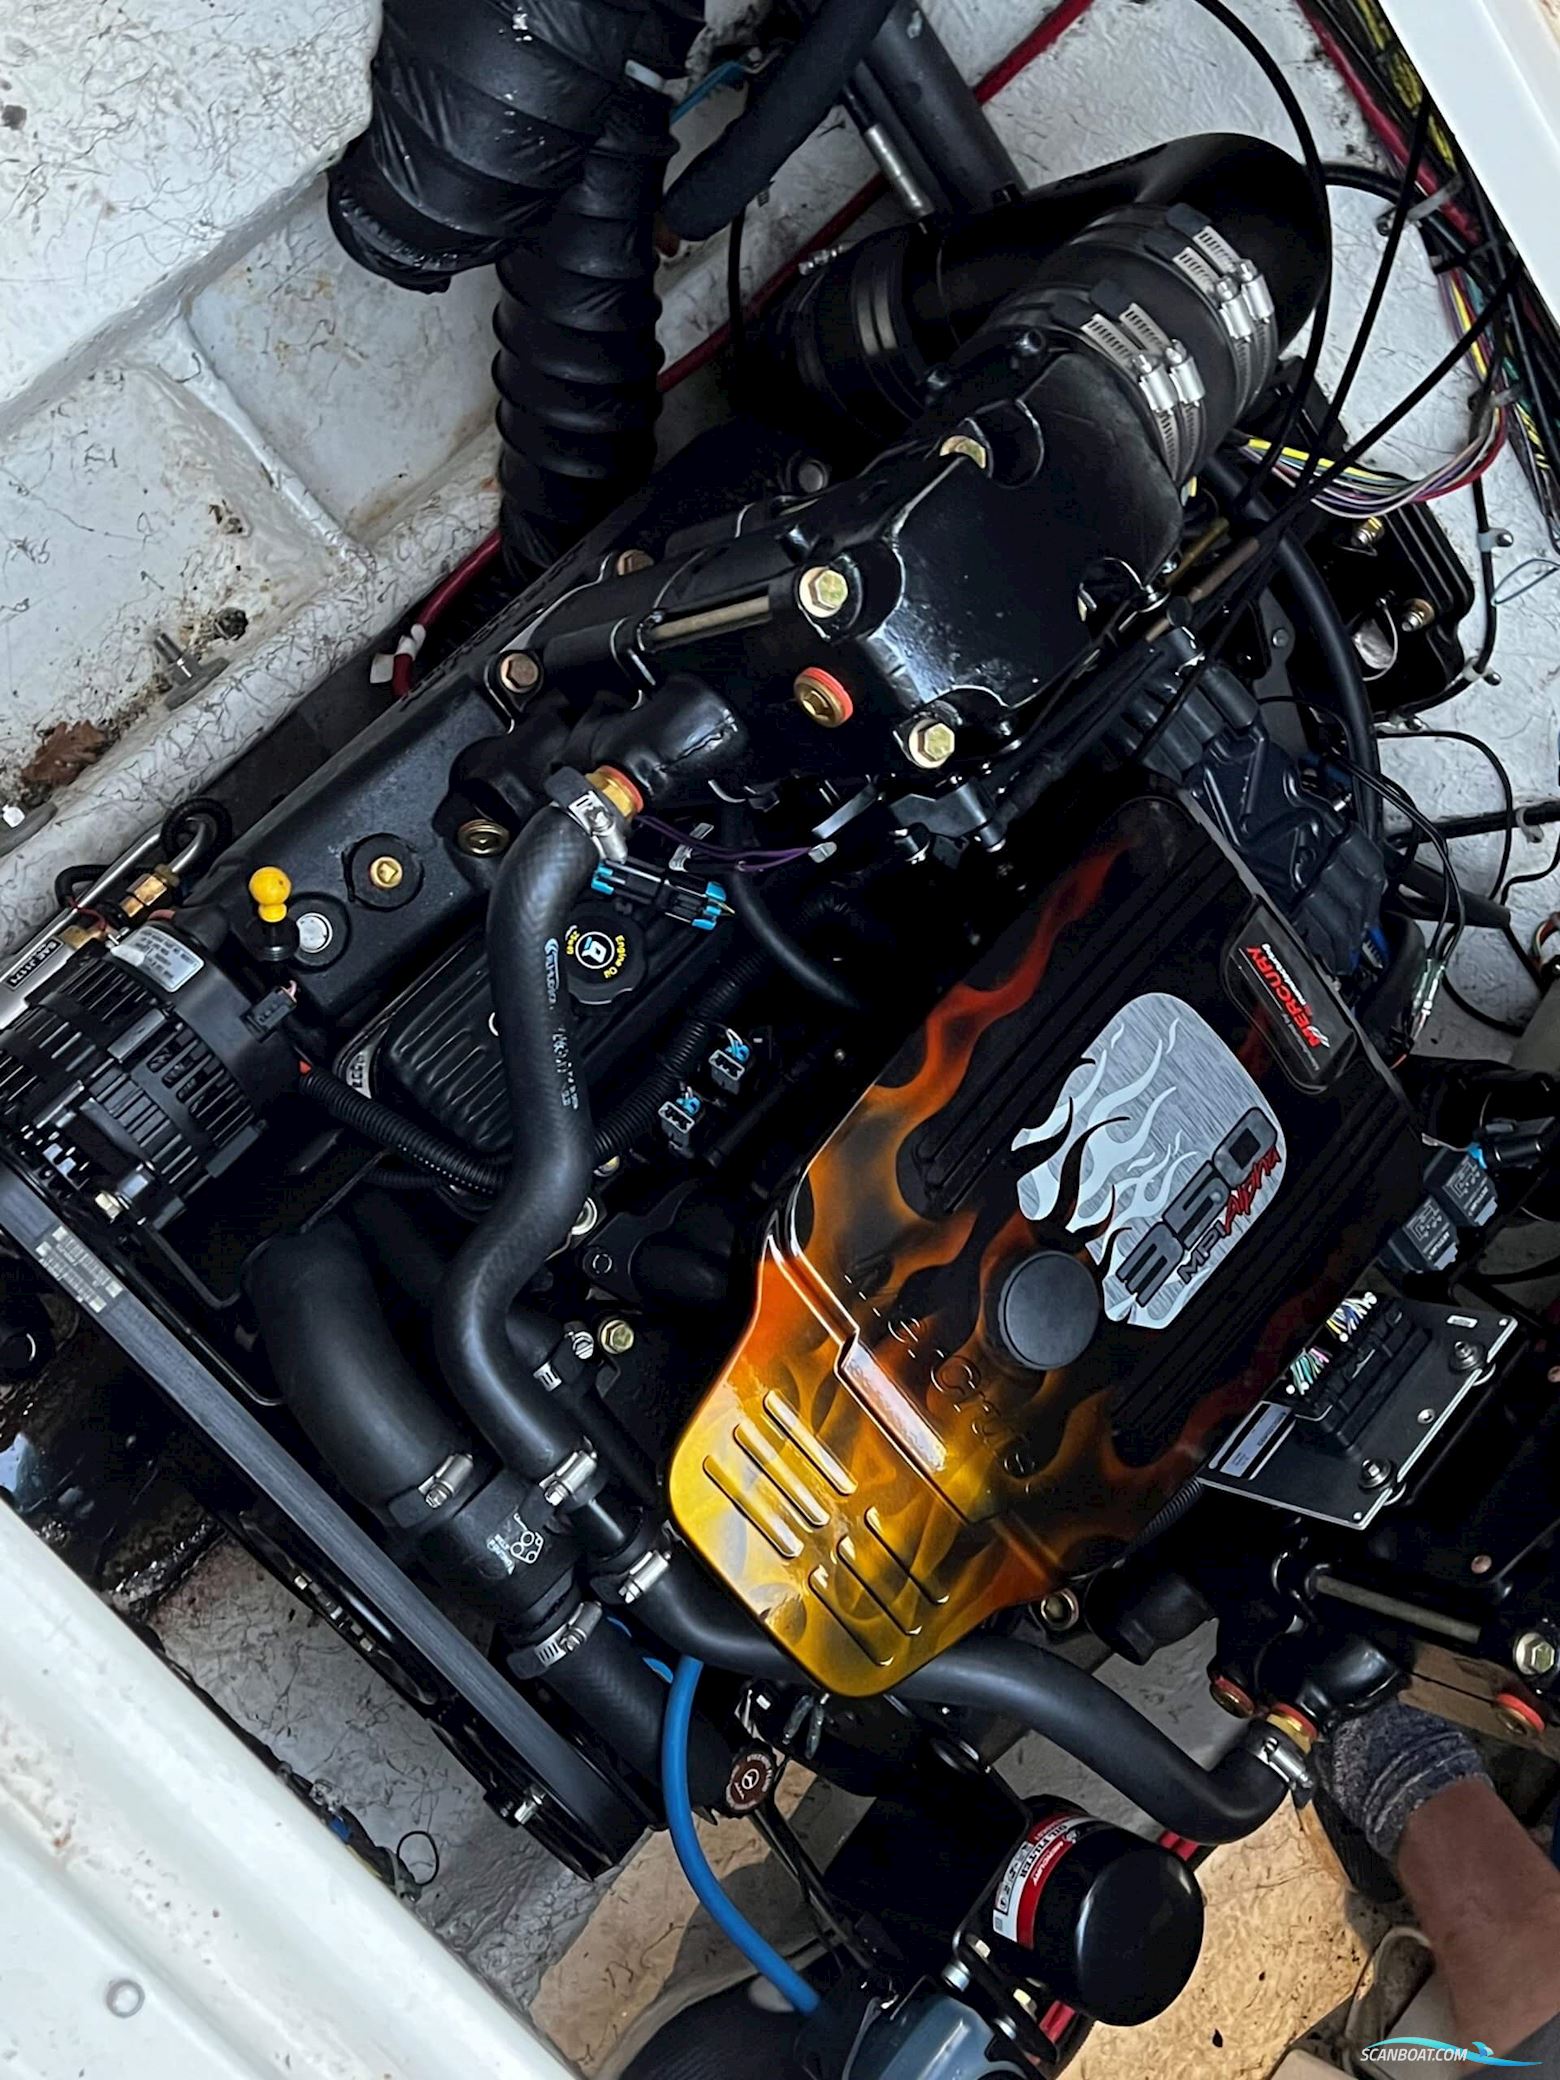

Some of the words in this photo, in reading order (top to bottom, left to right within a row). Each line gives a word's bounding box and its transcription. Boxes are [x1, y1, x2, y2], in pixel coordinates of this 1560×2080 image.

[36, 941, 57, 960] SAE
[615, 935, 627, 967] Engine
[1246, 946, 1322, 1048] MERCURY
[1115, 1106, 1278, 1308] 350
[1176, 1219, 1228, 1285] MPI
[1224, 1143, 1282, 1237] Alpha
[1048, 1824, 1069, 1839] OIL
[1020, 1839, 1050, 1878] FILTER
[1033, 1841, 1063, 1887] MERCURY
